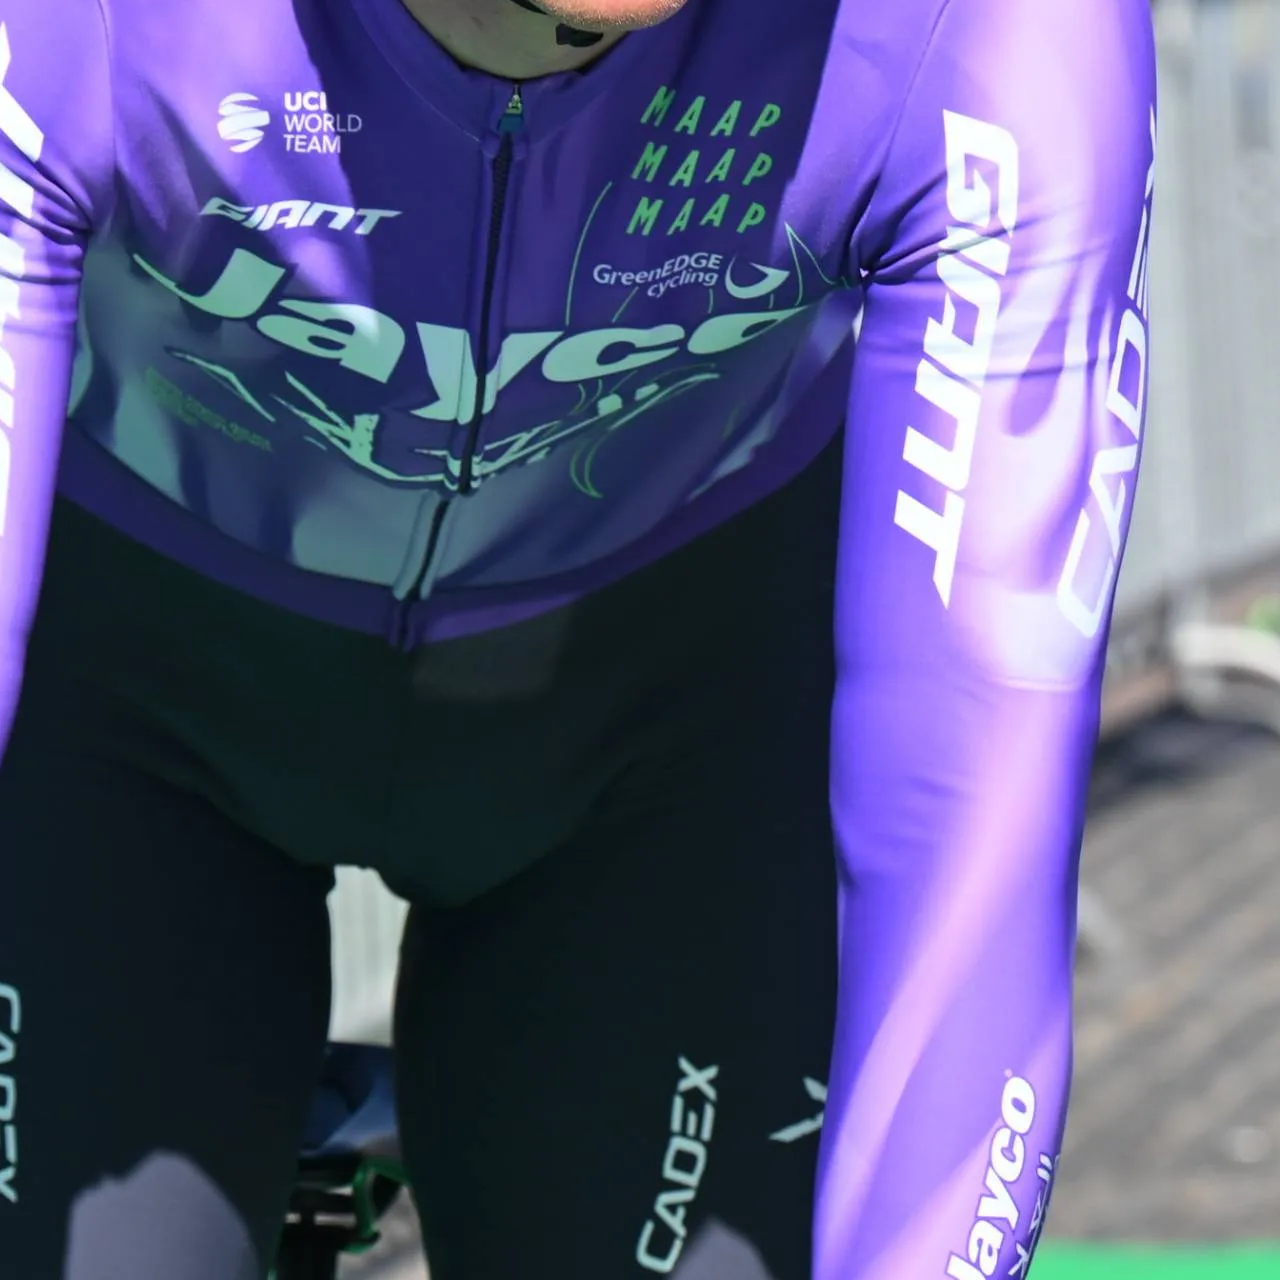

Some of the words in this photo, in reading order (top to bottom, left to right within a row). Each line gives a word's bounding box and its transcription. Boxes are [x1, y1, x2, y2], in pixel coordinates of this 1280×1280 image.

[283, 91, 328, 112] UCI
[639, 85, 782, 138] MAAP
[283, 113, 363, 134] WORLD
[283, 134, 342, 154] TEAM
[630, 141, 774, 188] MAAP
[200, 196, 403, 235] GIANT
[625, 194, 767, 237] MAAP
[592, 252, 724, 286] GreenEDGE
[646, 269, 719, 298] cycling
[132, 248, 810, 426] Jayco
[894, 109, 1019, 609] GIANT
[635, 1053, 720, 1274] CADEX
